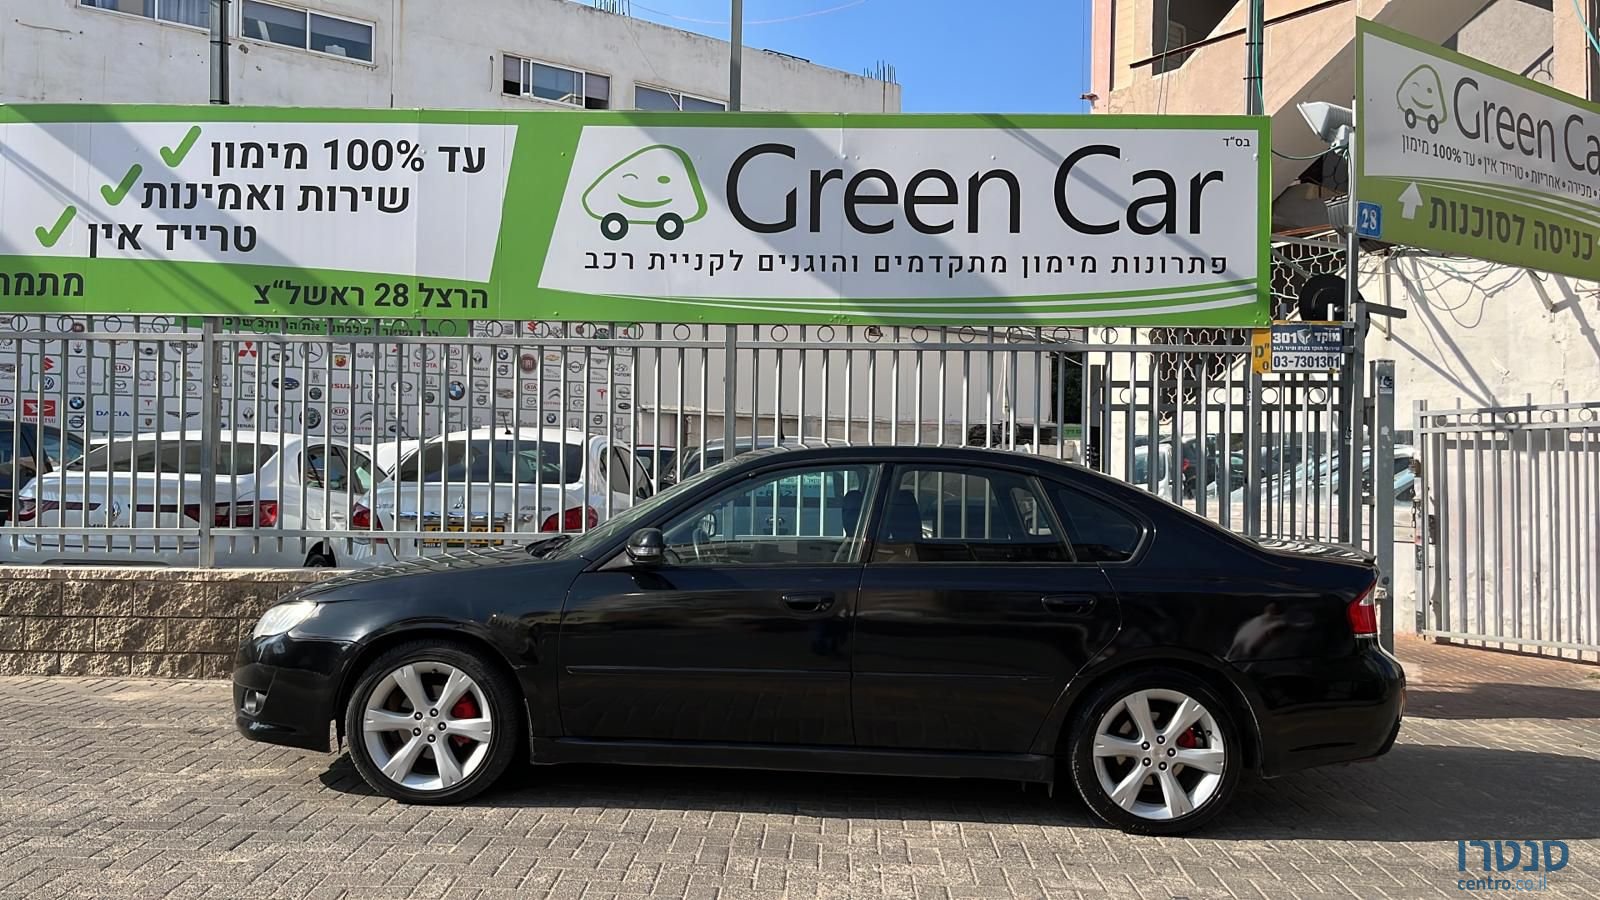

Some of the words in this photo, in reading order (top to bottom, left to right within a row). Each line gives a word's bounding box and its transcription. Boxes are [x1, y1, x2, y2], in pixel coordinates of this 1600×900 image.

[1453, 77, 1555, 163] Green
[1222, 136, 1251, 147] בס"ד
[1402, 134, 1429, 155] מימון
[1432, 143, 1462, 164] 100%
[211, 140, 307, 177] מימון
[323, 139, 425, 172] 100%
[437, 145, 486, 174] עד
[1463, 150, 1476, 167] עד
[1483, 156, 1498, 174] אין
[1500, 161, 1524, 180] טרייד
[1531, 170, 1561, 189] אחריות
[141, 180, 284, 211] ואמינות
[298, 184, 410, 214] שירות
[726, 143, 1020, 235] Green
[1053, 143, 1223, 235] Car
[1567, 180, 1592, 198] מכירה
[1361, 208, 1377, 231] 28
[1428, 197, 1525, 246] לסוכנות
[88, 222, 143, 258] אין
[156, 223, 257, 254] טרייד
[1534, 220, 1593, 261] כניסה
[585, 252, 635, 270] רכב
[648, 250, 743, 278] לקניית
[757, 253, 859, 274] והוגנים
[874, 254, 1007, 279] מתקדמים
[1021, 255, 1097, 279] מימון
[1110, 256, 1227, 275] פתרונות
[254, 279, 365, 306] ראשל"צ
[374, 282, 409, 307] 28
[418, 282, 488, 309] הרצל
[1272, 332, 1298, 344] 301
[1314, 330, 1340, 344] מוקד
[413, 361, 438, 369] TOOTA
[1273, 355, 1340, 368] 03-7301301
